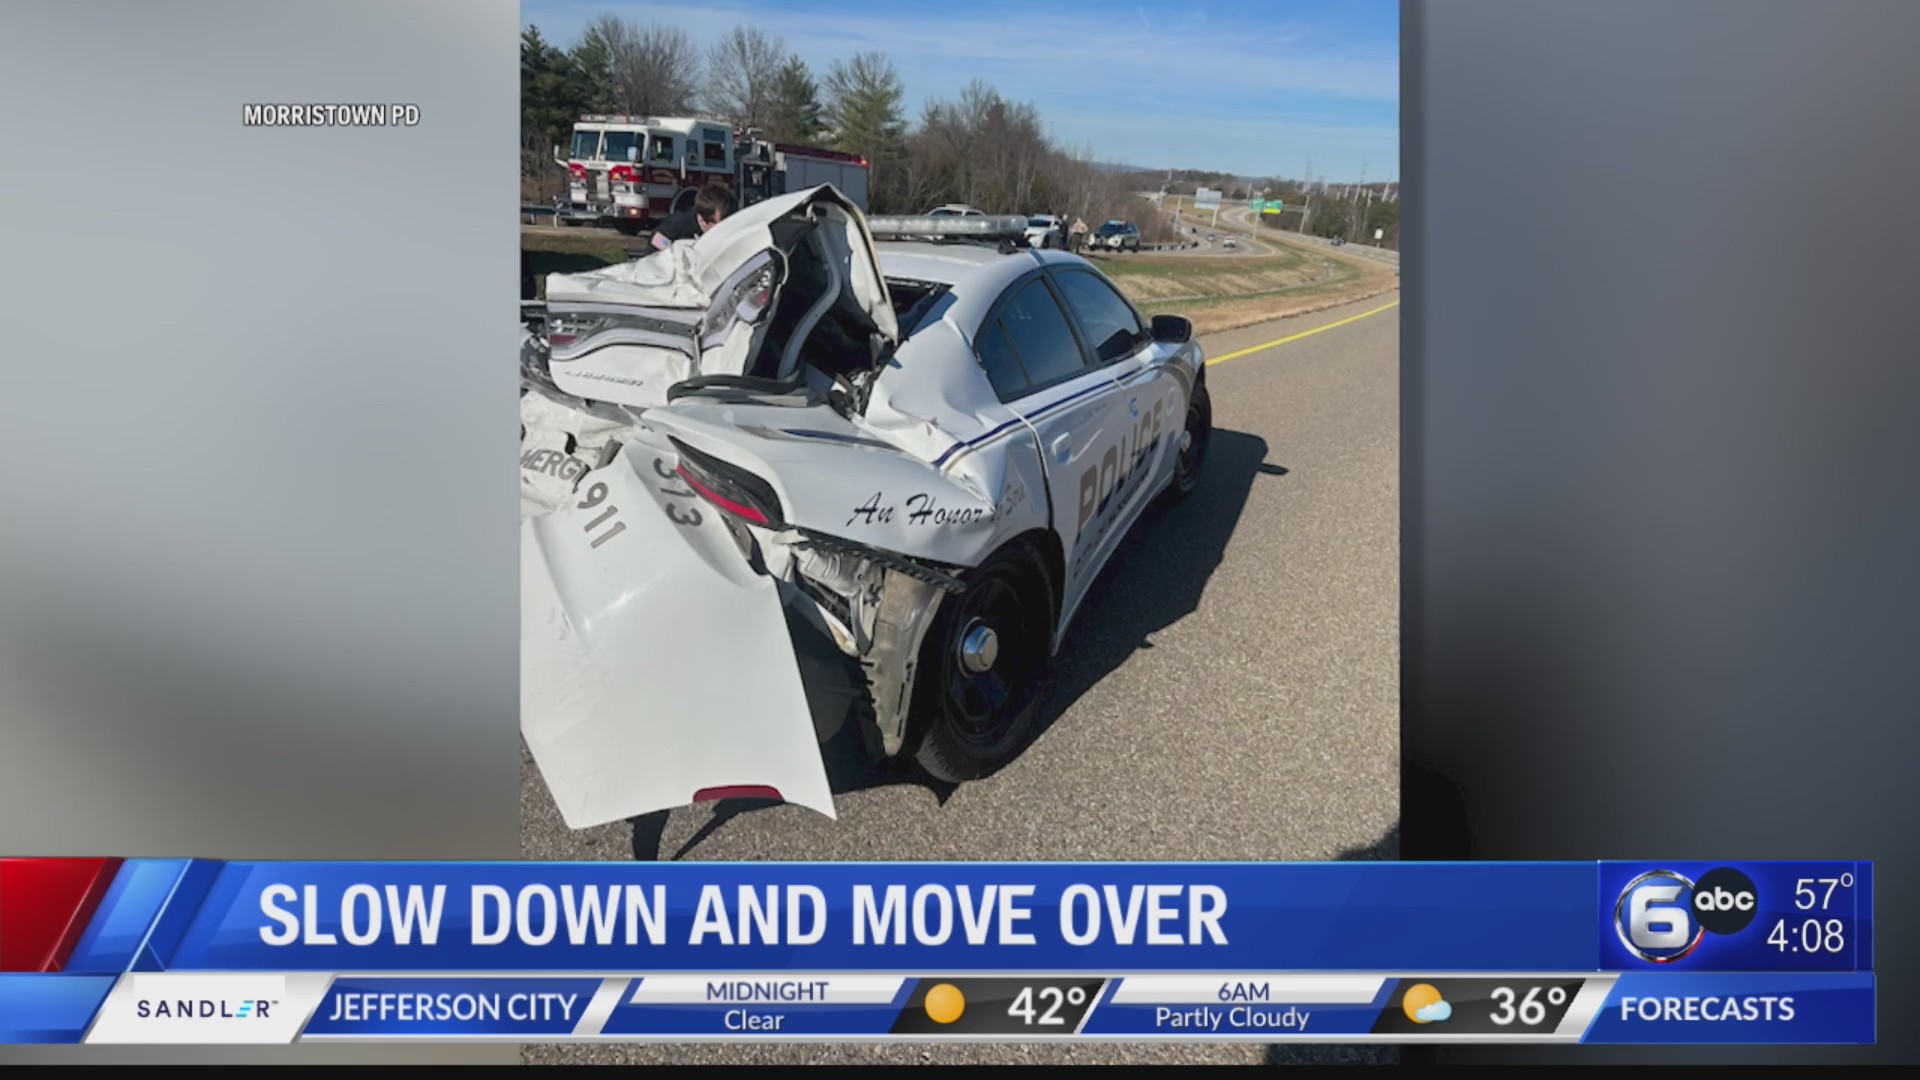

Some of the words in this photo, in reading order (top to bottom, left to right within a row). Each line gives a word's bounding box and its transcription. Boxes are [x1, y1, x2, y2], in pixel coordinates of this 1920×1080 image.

[1076, 397, 1164, 546] POLICE
[577, 482, 627, 549] 911
[846, 491, 894, 527] An
[906, 493, 984, 526] Honor
